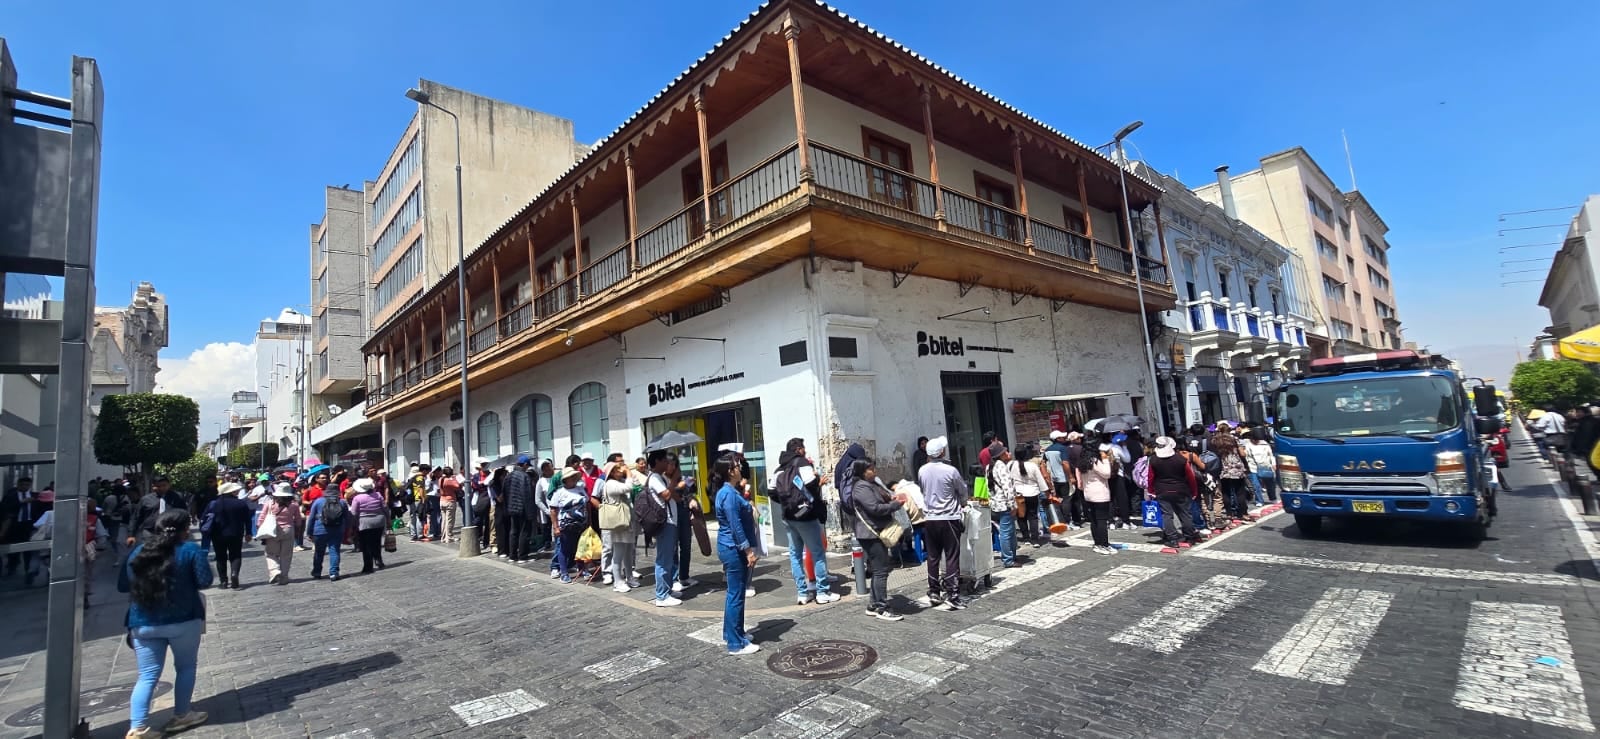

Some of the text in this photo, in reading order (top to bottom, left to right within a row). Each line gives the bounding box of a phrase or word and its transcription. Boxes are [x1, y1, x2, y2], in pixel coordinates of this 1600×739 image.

[929, 335, 964, 356] bitel
[657, 377, 686, 402] bitel
[1342, 460, 1386, 469] JAC
